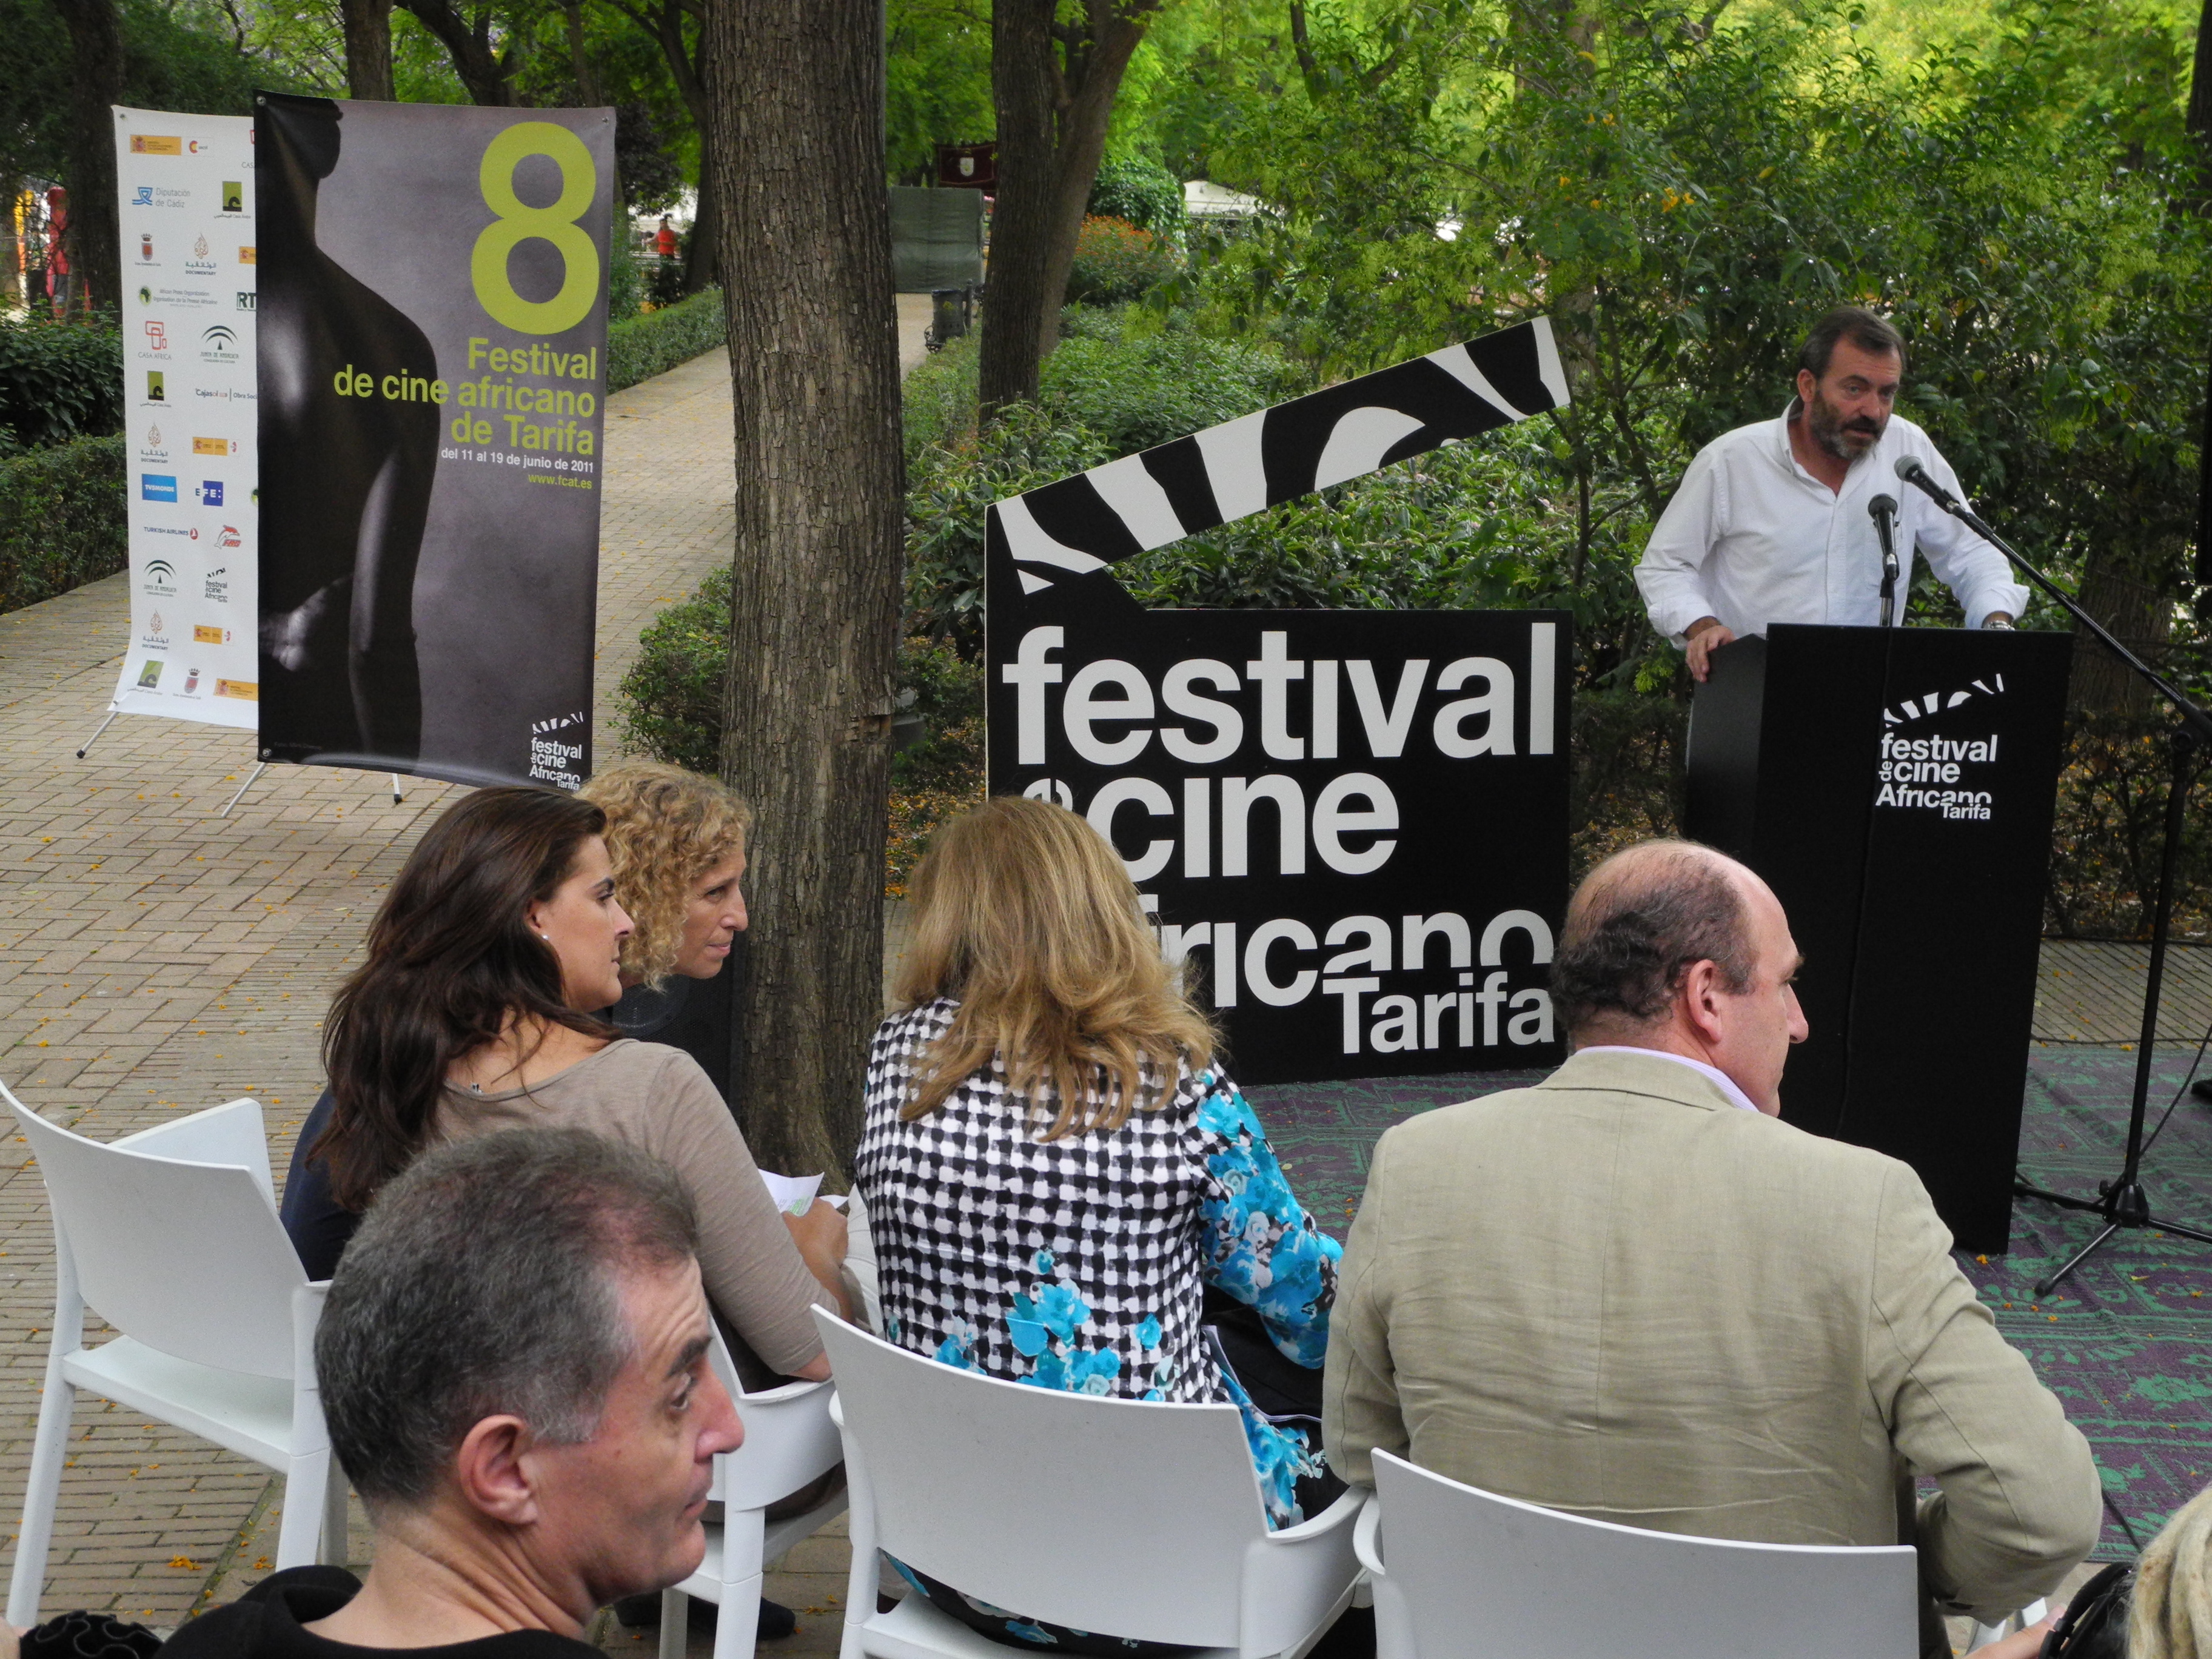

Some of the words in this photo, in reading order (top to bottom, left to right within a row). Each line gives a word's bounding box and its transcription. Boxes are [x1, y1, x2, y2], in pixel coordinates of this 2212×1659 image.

[156, 187, 191, 197] Diputación
[471, 121, 600, 335] 8
[236, 292, 256, 309] RT
[468, 337, 597, 380] Festival
[195, 388, 218, 398] Cajasol
[334, 364, 374, 398] de
[382, 368, 449, 404] cine
[458, 375, 595, 418] africano
[451, 411, 493, 444] de
[503, 414, 594, 455] Tarifa
[441, 447, 458, 460] del
[461, 449, 472, 461] 11
[477, 451, 487, 463] al
[491, 452, 503, 464] 19
[506, 454, 520, 465] de
[523, 455, 552, 469] junio
[554, 458, 569, 470] de
[571, 460, 594, 473] 2011
[528, 474, 592, 489] www.fcat.es
[206, 580, 228, 589] festival
[1002, 622, 1556, 765] festival
[531, 737, 582, 760] festival
[1881, 732, 1998, 762] festival
[531, 752, 537, 764] de
[537, 753, 567, 769] cine
[1879, 760, 1893, 782] de
[1894, 762, 1961, 783] cine
[529, 764, 581, 782] Africano
[555, 778, 580, 791] Tarifa
[1875, 783, 1992, 808] Africano
[1940, 802, 1991, 820] Tarifa
[1086, 773, 1399, 883] cine
[1322, 971, 1555, 1055] Tarifa
